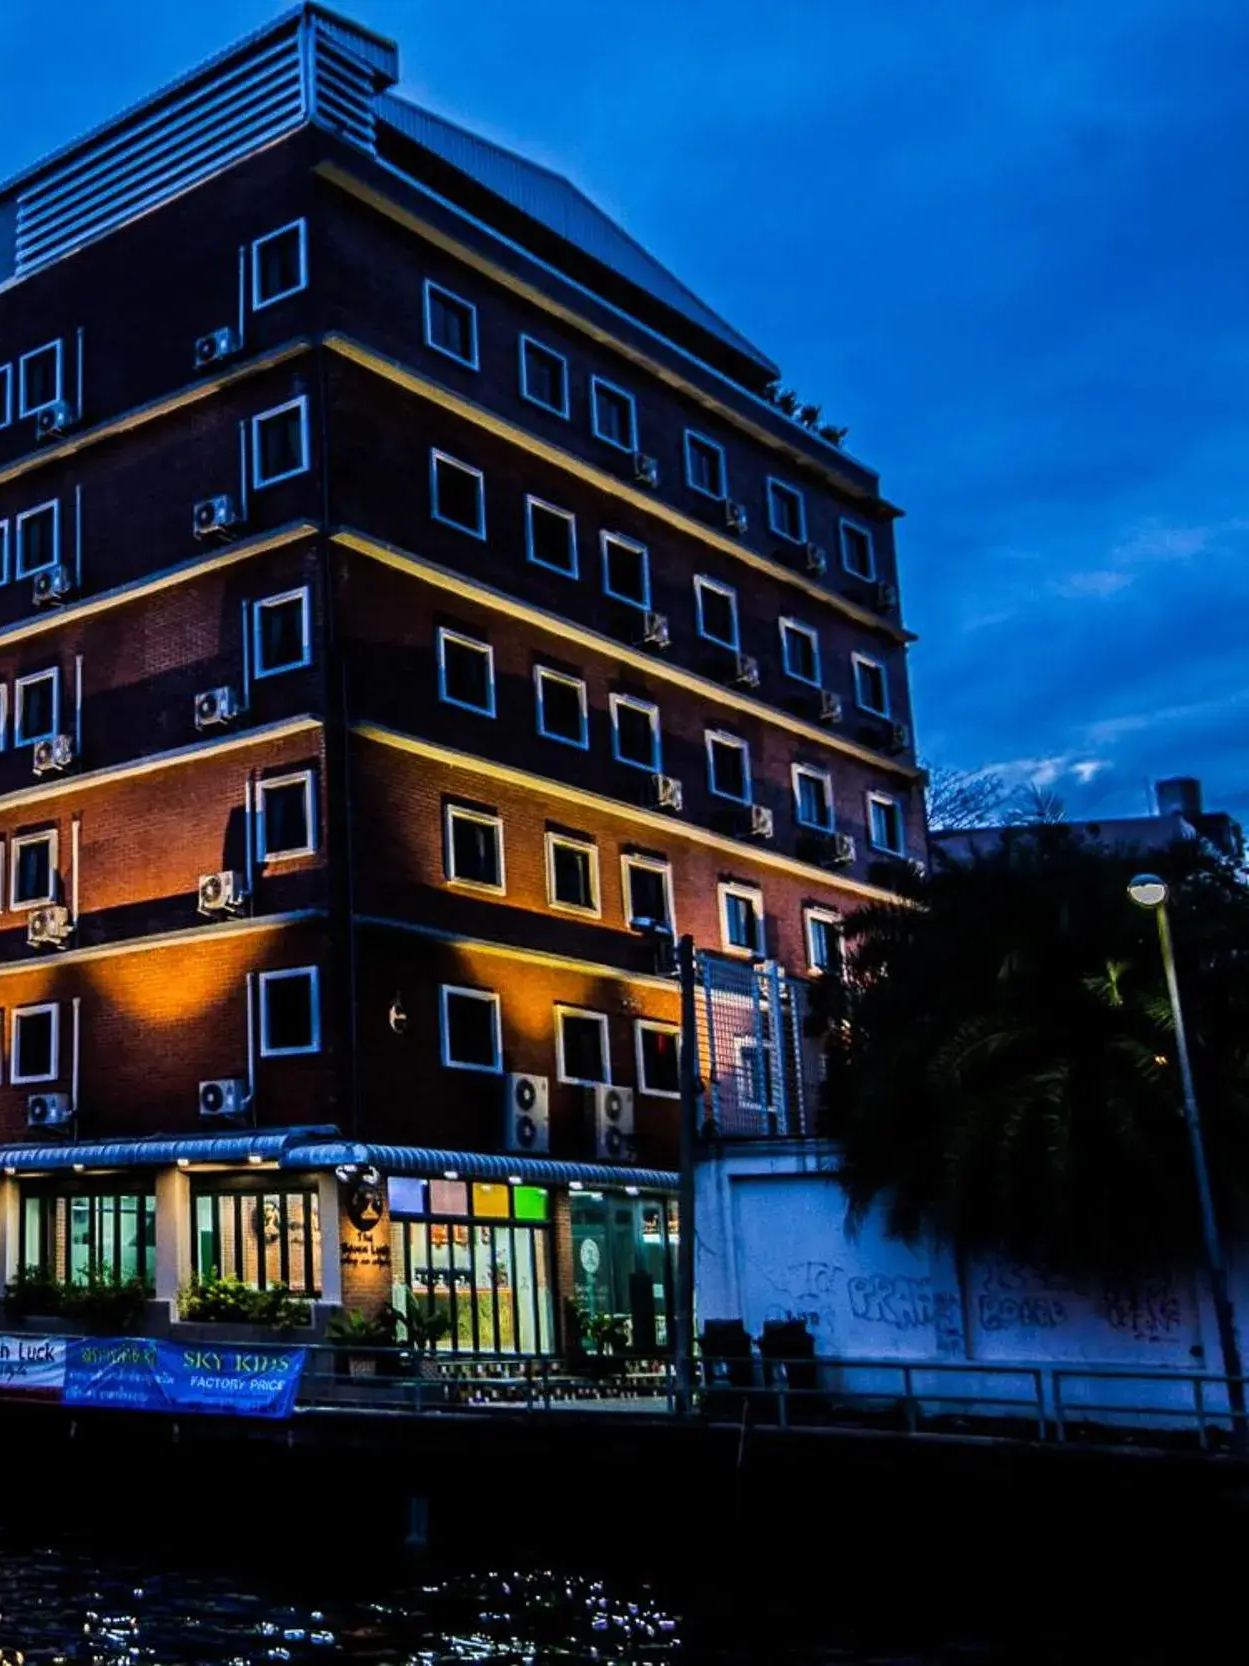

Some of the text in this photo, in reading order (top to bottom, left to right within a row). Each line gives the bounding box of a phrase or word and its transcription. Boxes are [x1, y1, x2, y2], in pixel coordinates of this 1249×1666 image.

[18, 1342, 55, 1361] Luck
[183, 1351, 290, 1373] SKY KIDS
[190, 1375, 246, 1391] FACTORY
[249, 1379, 287, 1391] PRICE
